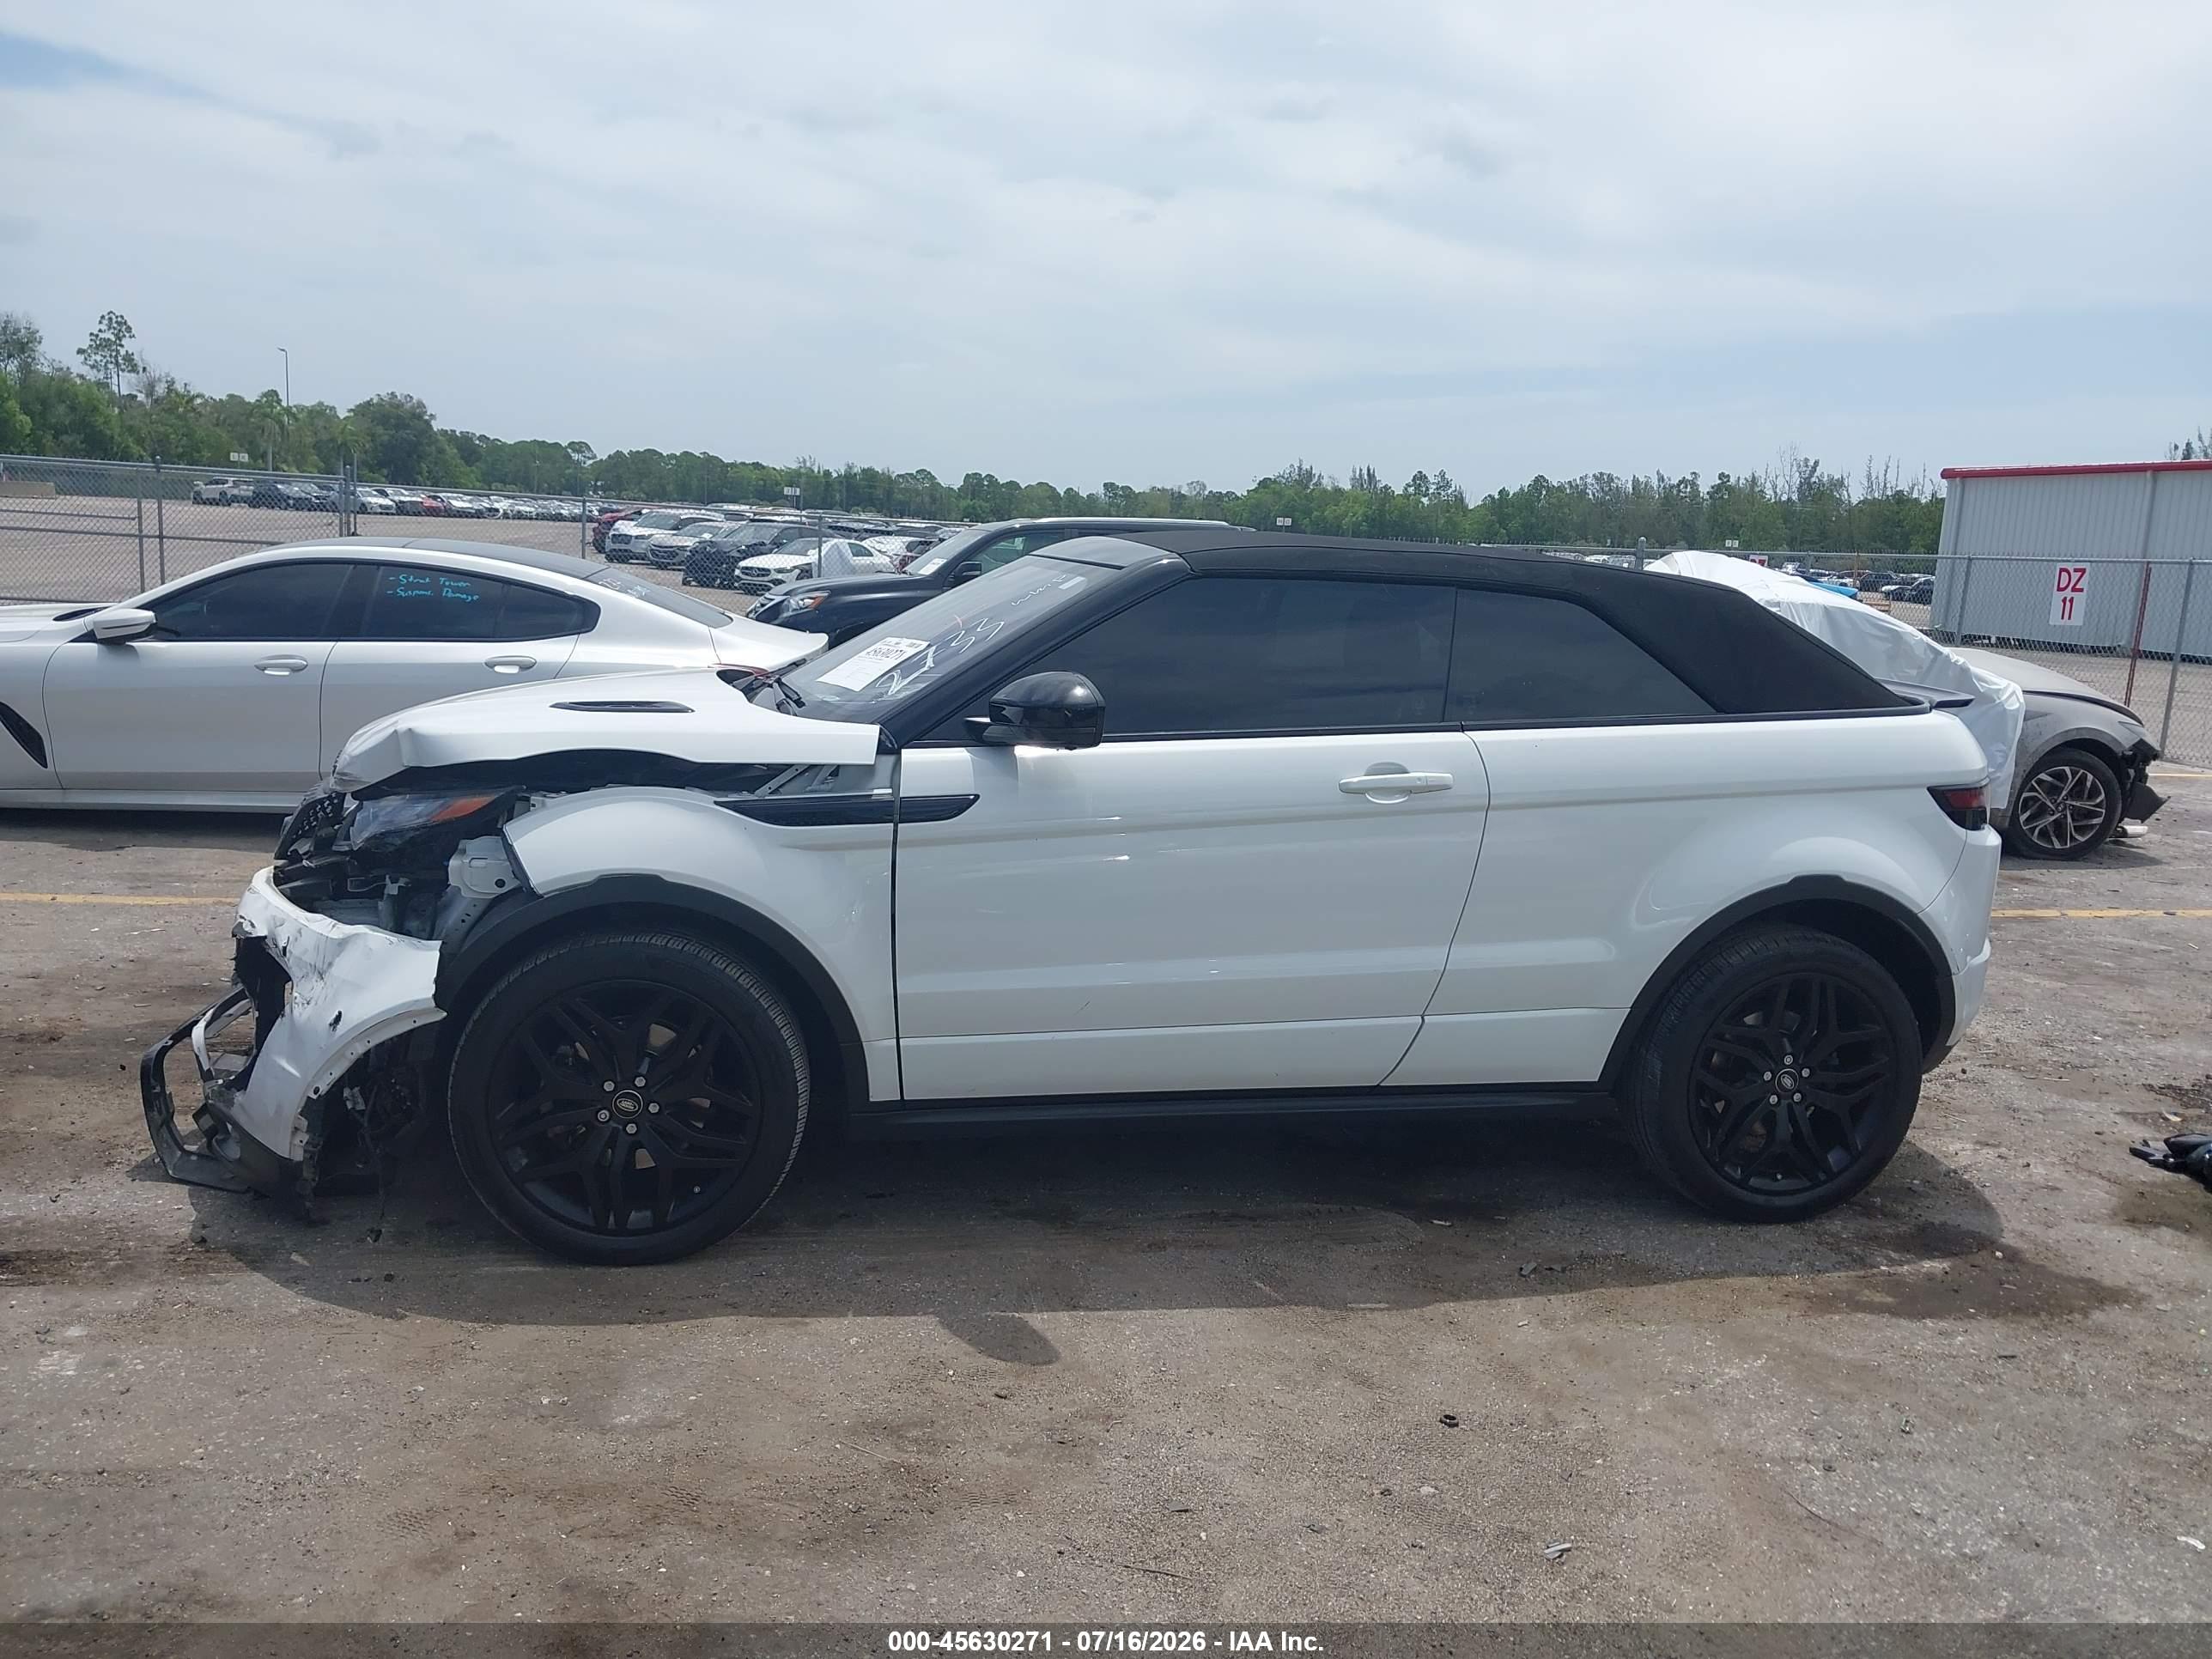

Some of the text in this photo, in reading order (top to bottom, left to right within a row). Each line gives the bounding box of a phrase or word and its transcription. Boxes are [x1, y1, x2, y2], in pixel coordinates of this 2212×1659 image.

[439, 576, 471, 587] Tower
[2057, 568, 2087, 592] DZ
[442, 588, 480, 602] Damage
[2061, 596, 2074, 620] 11
